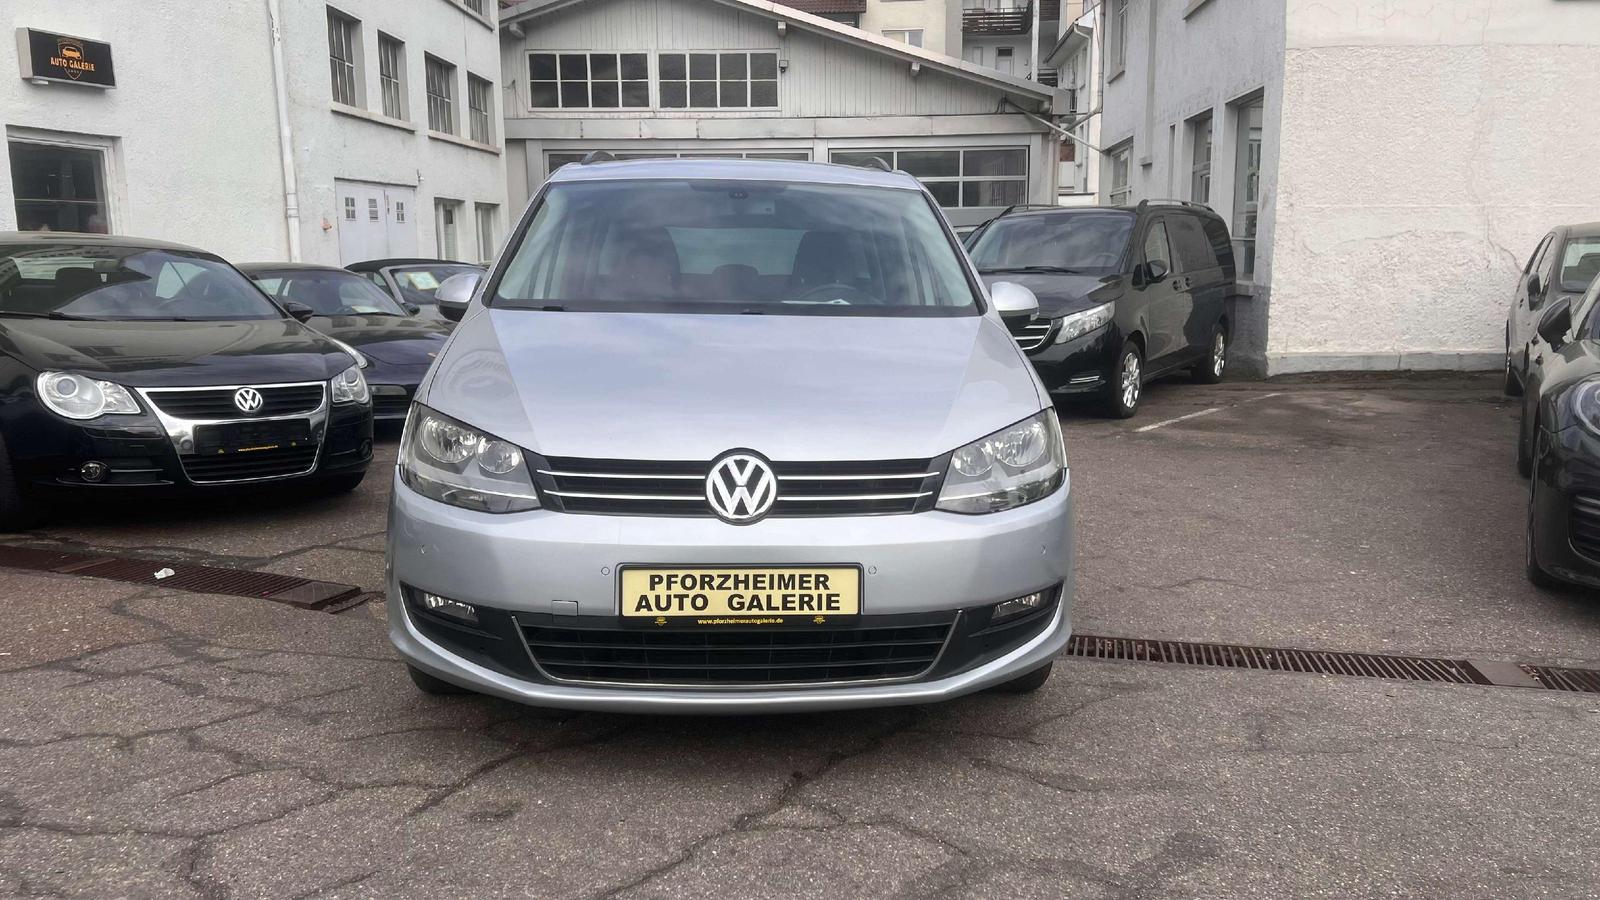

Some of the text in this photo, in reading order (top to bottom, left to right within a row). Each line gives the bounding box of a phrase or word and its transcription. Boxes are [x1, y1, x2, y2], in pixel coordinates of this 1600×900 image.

[50, 57, 67, 67] AUTO
[69, 60, 95, 72] GALERIE
[706, 455, 777, 519] VW
[649, 573, 830, 591] PFORZHEIMER
[634, 593, 841, 612] AUTO GALERIE
[697, 617, 784, 625] www.pforzheimerautogalerie.de
